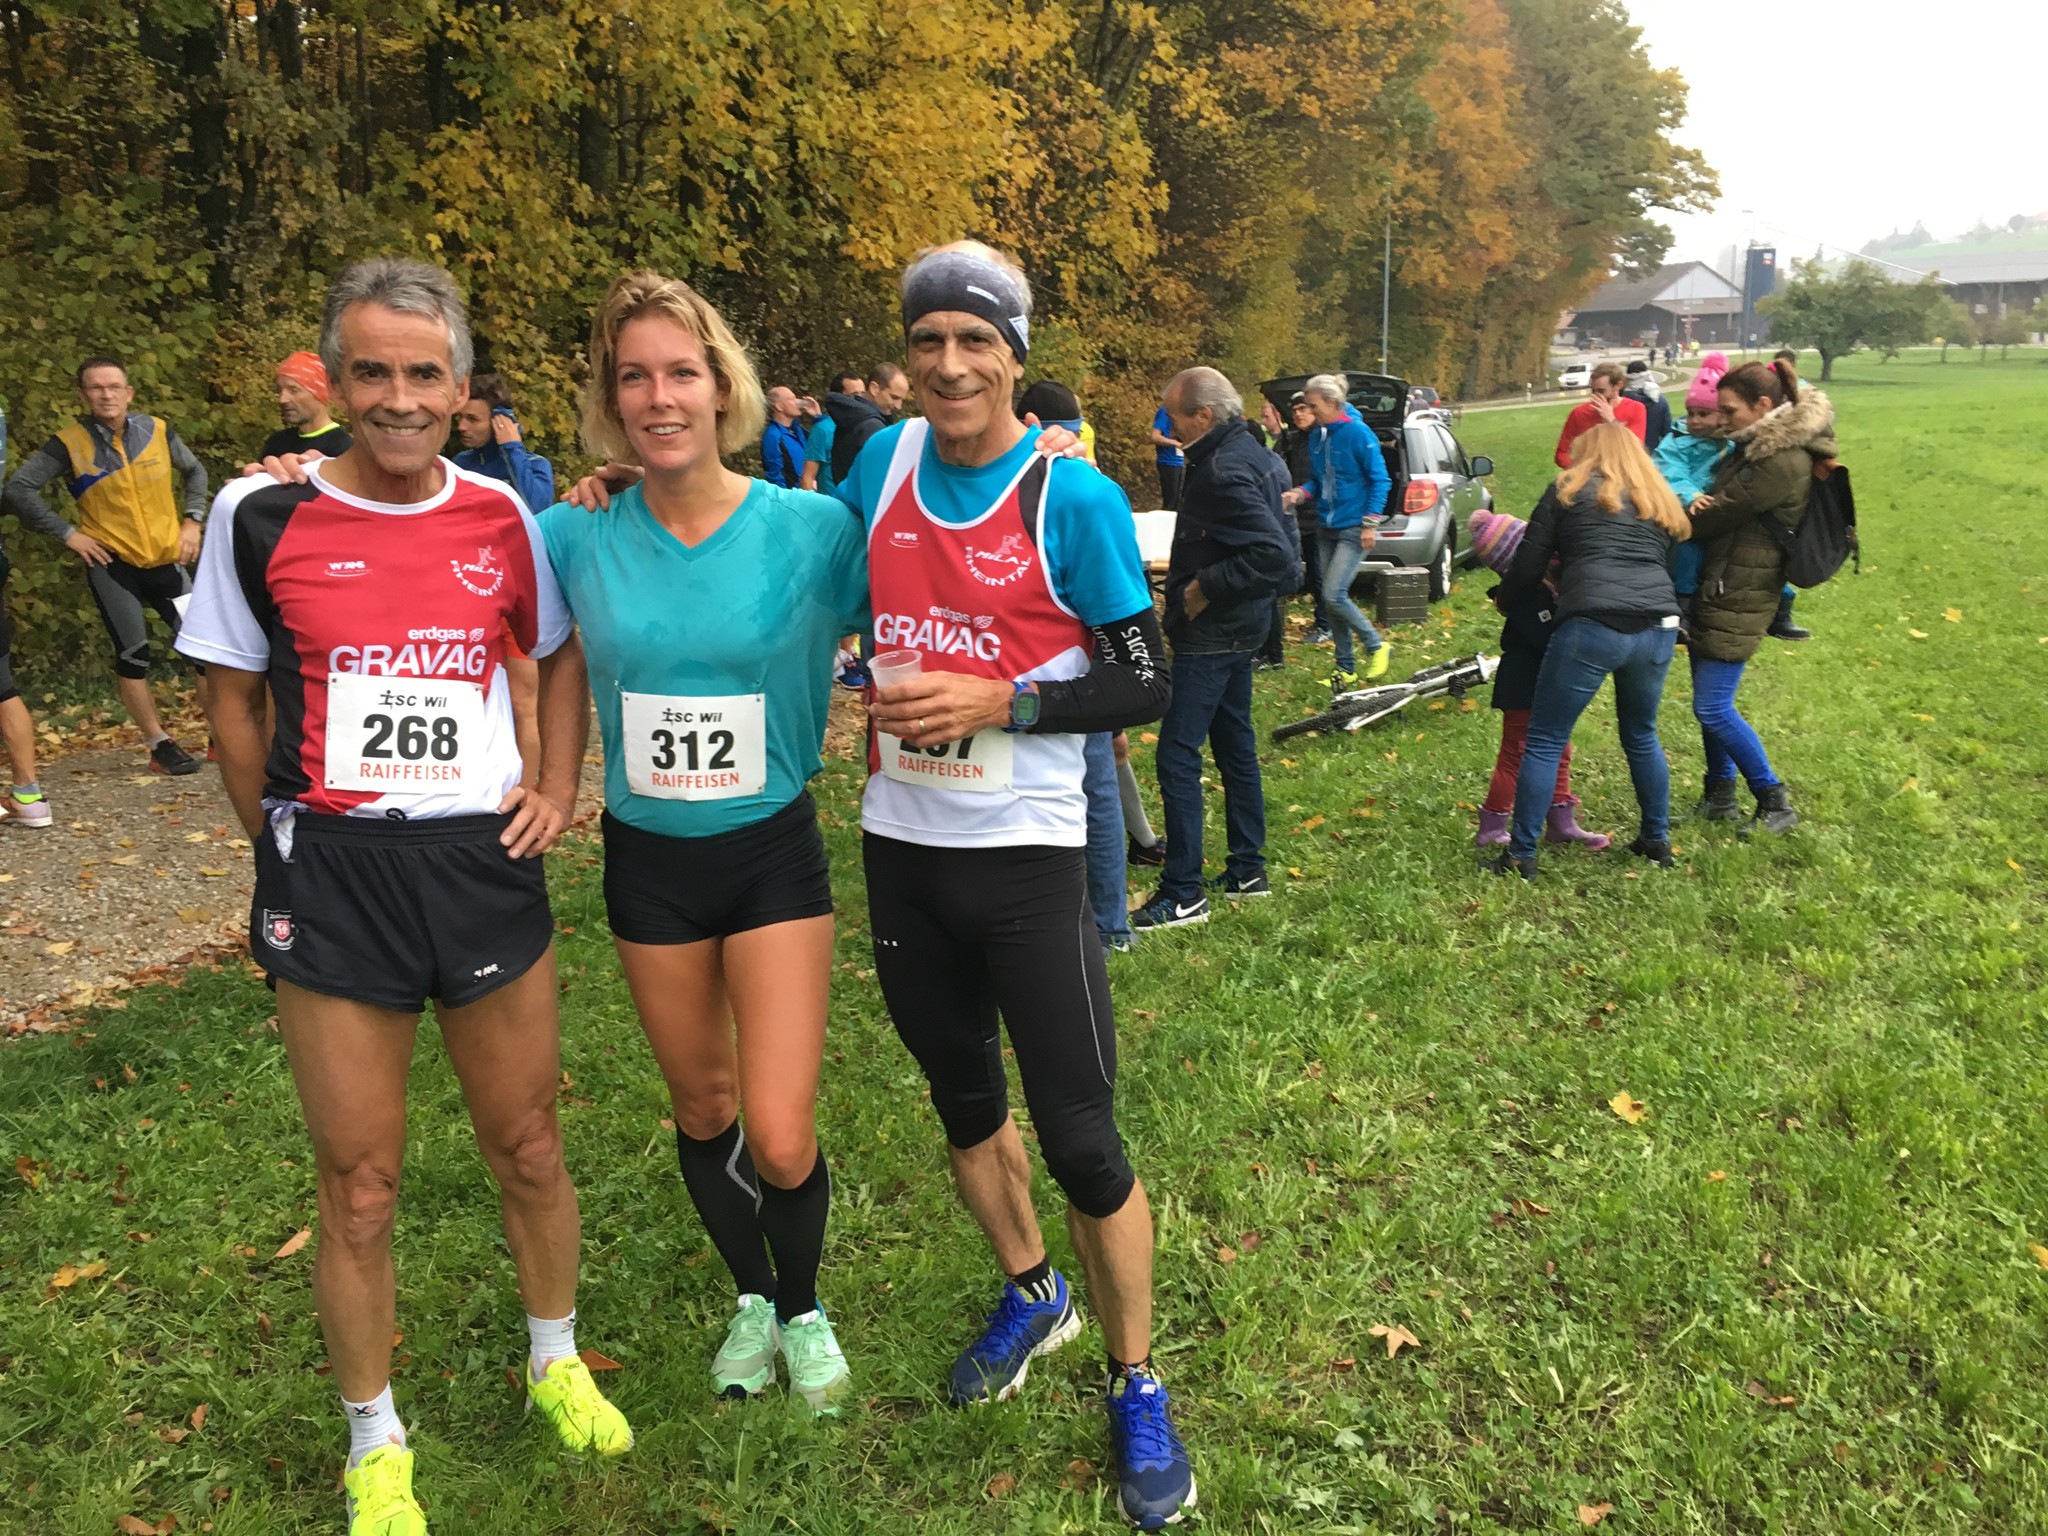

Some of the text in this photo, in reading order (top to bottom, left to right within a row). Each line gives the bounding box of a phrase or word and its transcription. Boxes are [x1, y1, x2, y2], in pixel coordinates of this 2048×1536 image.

[408, 626, 466, 642] erdgas
[874, 613, 1001, 662] GRAVAG
[329, 643, 487, 677] GRAVAG
[361, 713, 459, 761] 268
[651, 729, 735, 770] 312
[360, 762, 462, 780] RAIFFEISEN
[652, 772, 740, 789] RAIFFEISEN
[898, 754, 983, 779] RAIFFEISEN
